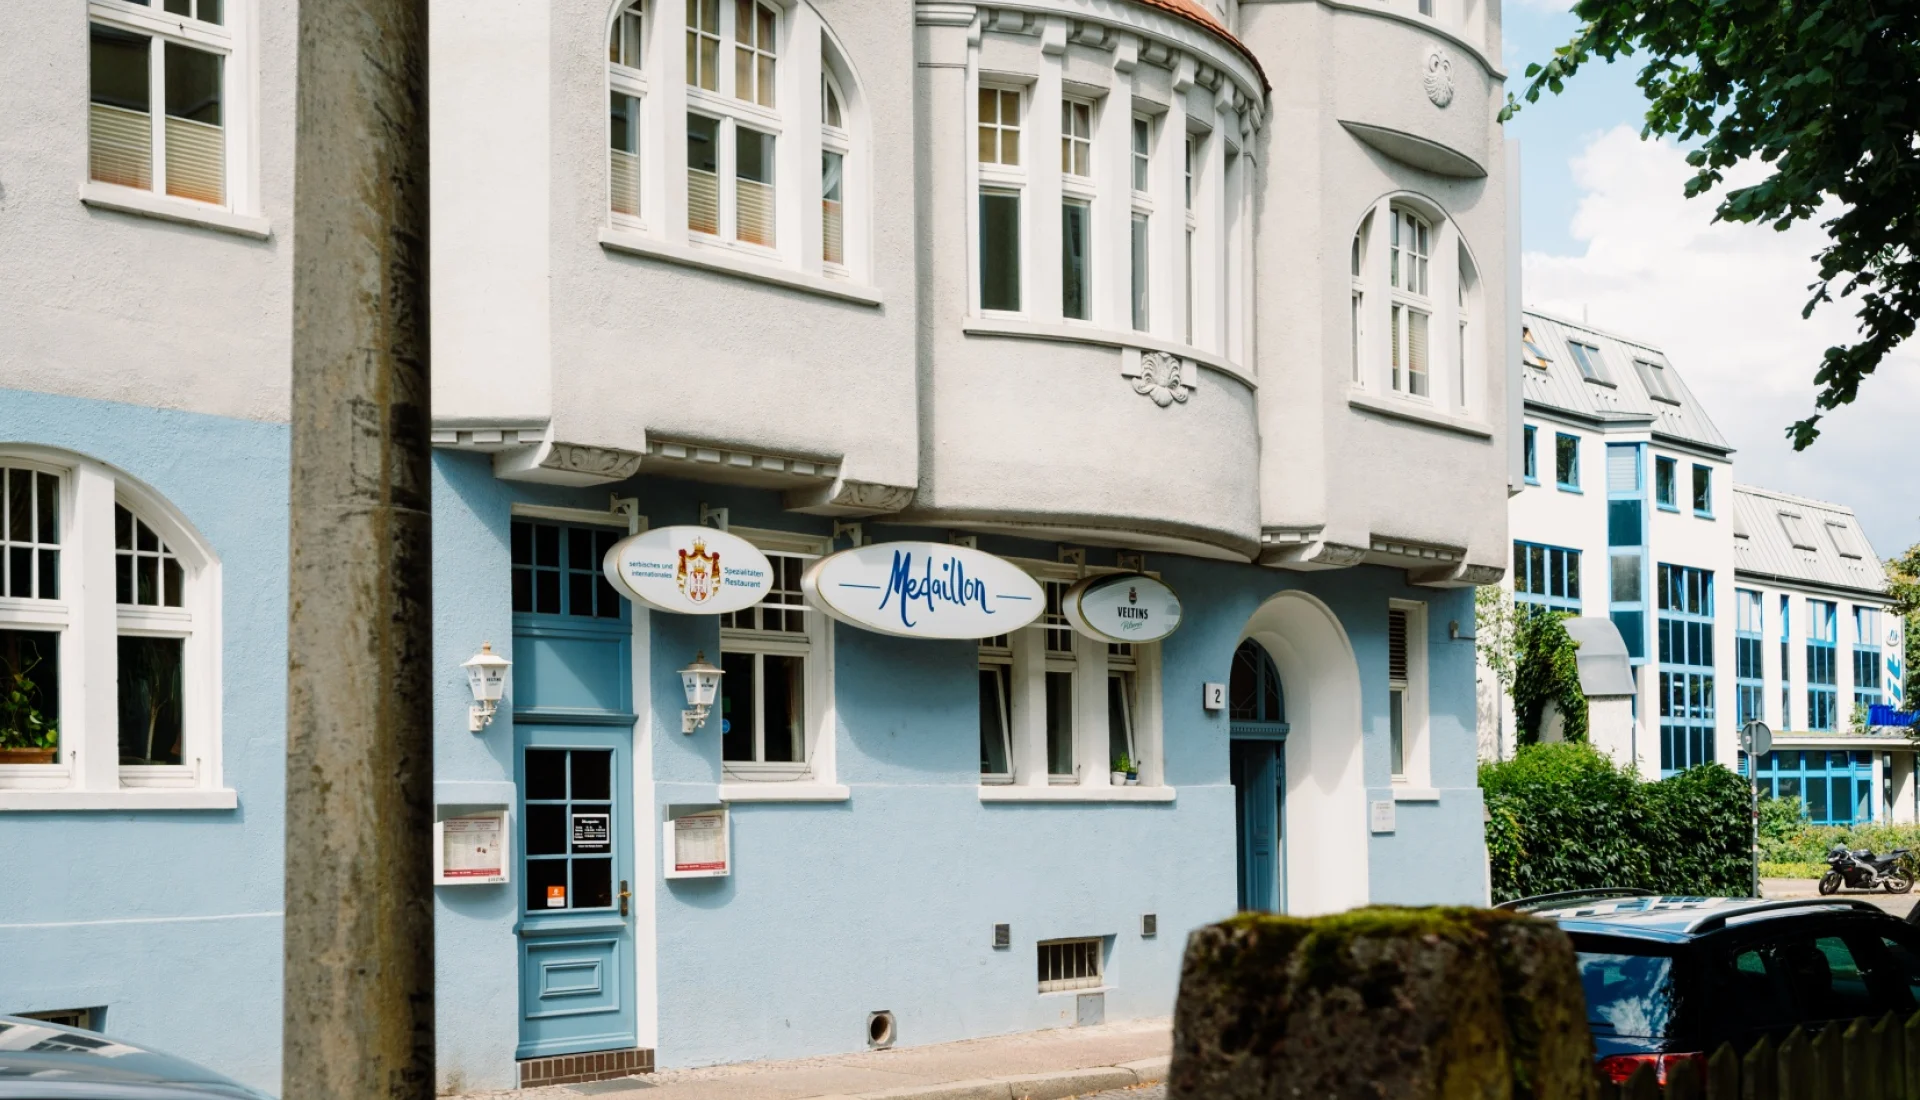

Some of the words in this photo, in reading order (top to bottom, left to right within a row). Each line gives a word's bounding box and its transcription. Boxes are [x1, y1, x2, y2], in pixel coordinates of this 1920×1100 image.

[629, 561, 661, 569] serbisches
[631, 570, 673, 579] internationales
[724, 577, 761, 588] Restaurant
[878, 549, 996, 628] Medaillon
[1117, 606, 1149, 620] VELTINS
[1214, 688, 1221, 704] 2
